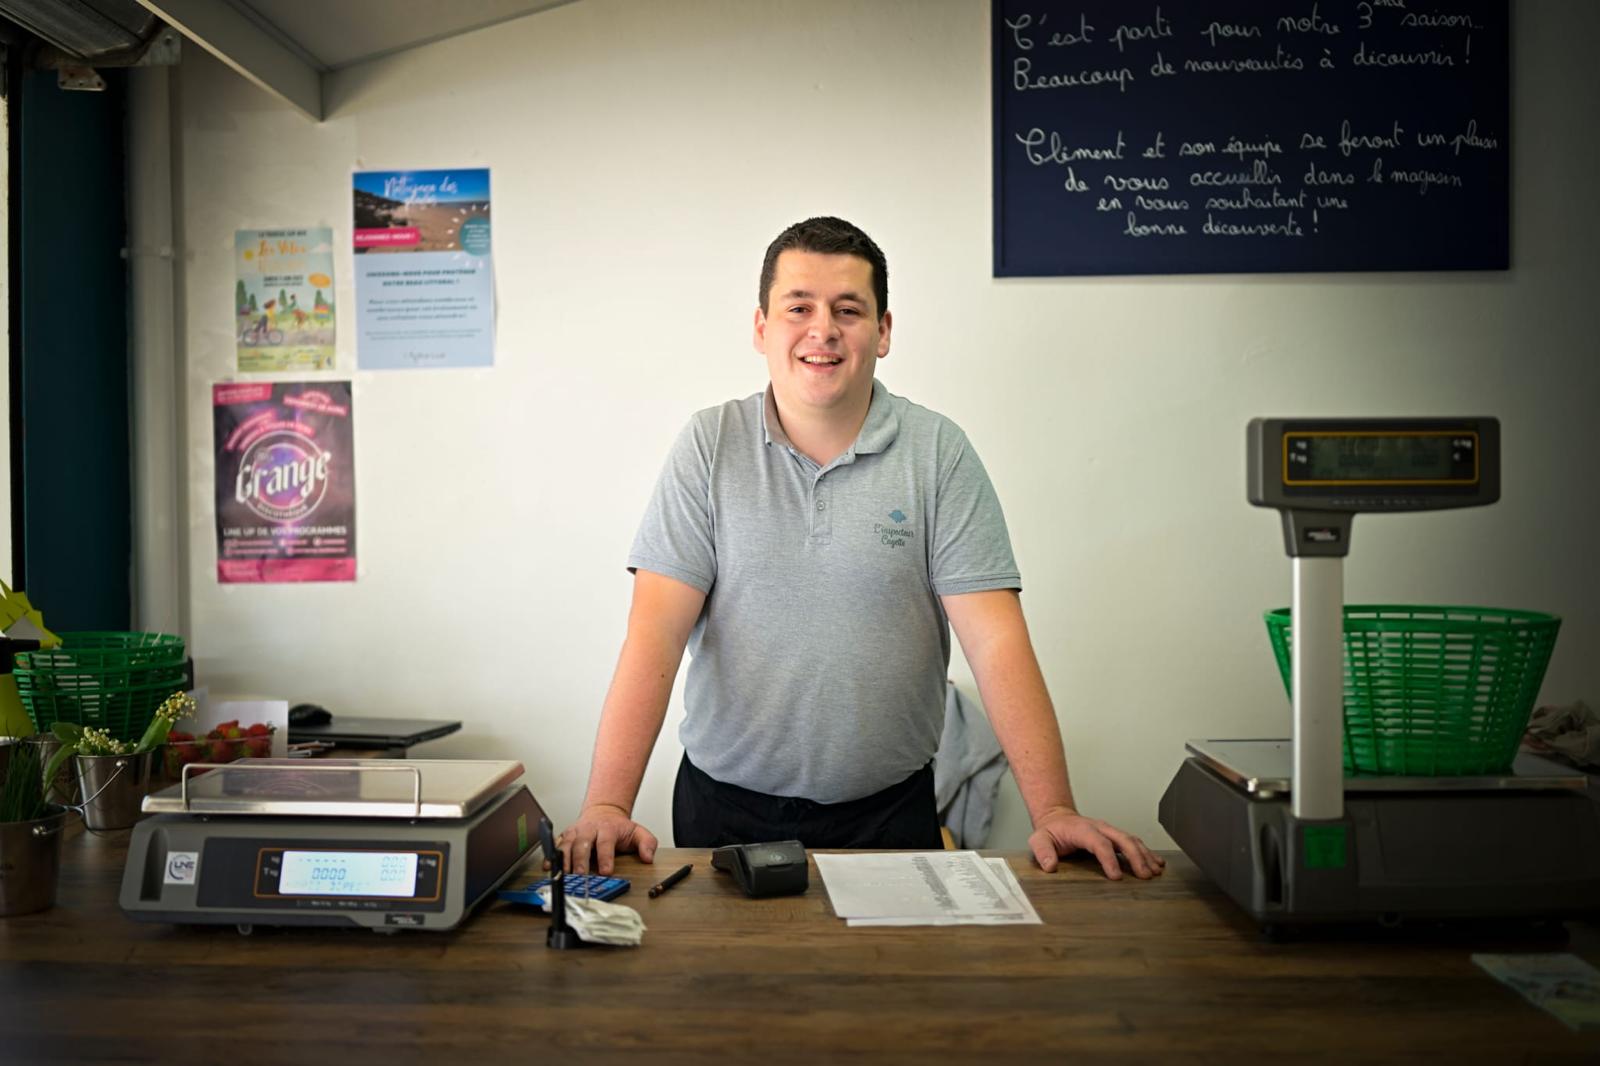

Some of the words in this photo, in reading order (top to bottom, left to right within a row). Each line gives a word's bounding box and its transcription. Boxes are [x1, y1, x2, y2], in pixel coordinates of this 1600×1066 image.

[1109, 6, 1172, 53] parti
[1201, 22, 1261, 46] pour
[1277, 3, 1340, 34] notre
[1014, 57, 1134, 92] Beaucoup
[1151, 52, 1176, 76] de
[1184, 43, 1304, 72] nouveautés
[1320, 48, 1335, 68] à
[1353, 42, 1454, 67] découvrir
[1465, 35, 1470, 64] !
[1016, 128, 1125, 165] Clément
[1142, 132, 1165, 158] et
[1179, 142, 1215, 156] son
[1222, 135, 1282, 162] équipe
[1300, 133, 1326, 149] se
[1338, 120, 1404, 156] feront
[1418, 133, 1446, 146] un
[1450, 119, 1497, 155] plaisir
[1065, 167, 1089, 192] de
[1104, 175, 1169, 191] vous
[1190, 157, 1281, 186] accueillir
[1304, 162, 1354, 185] dans
[1367, 158, 1383, 183] le
[1391, 170, 1462, 195] magasin
[1097, 198, 1122, 211] en
[1136, 195, 1189, 210] vous
[1205, 187, 1306, 210] souhaitant
[1317, 197, 1348, 208] une
[1124, 211, 1187, 237] bonne
[1202, 212, 1303, 236] découverte
[1313, 209, 1318, 232] !
[235, 451, 332, 503] Grange
